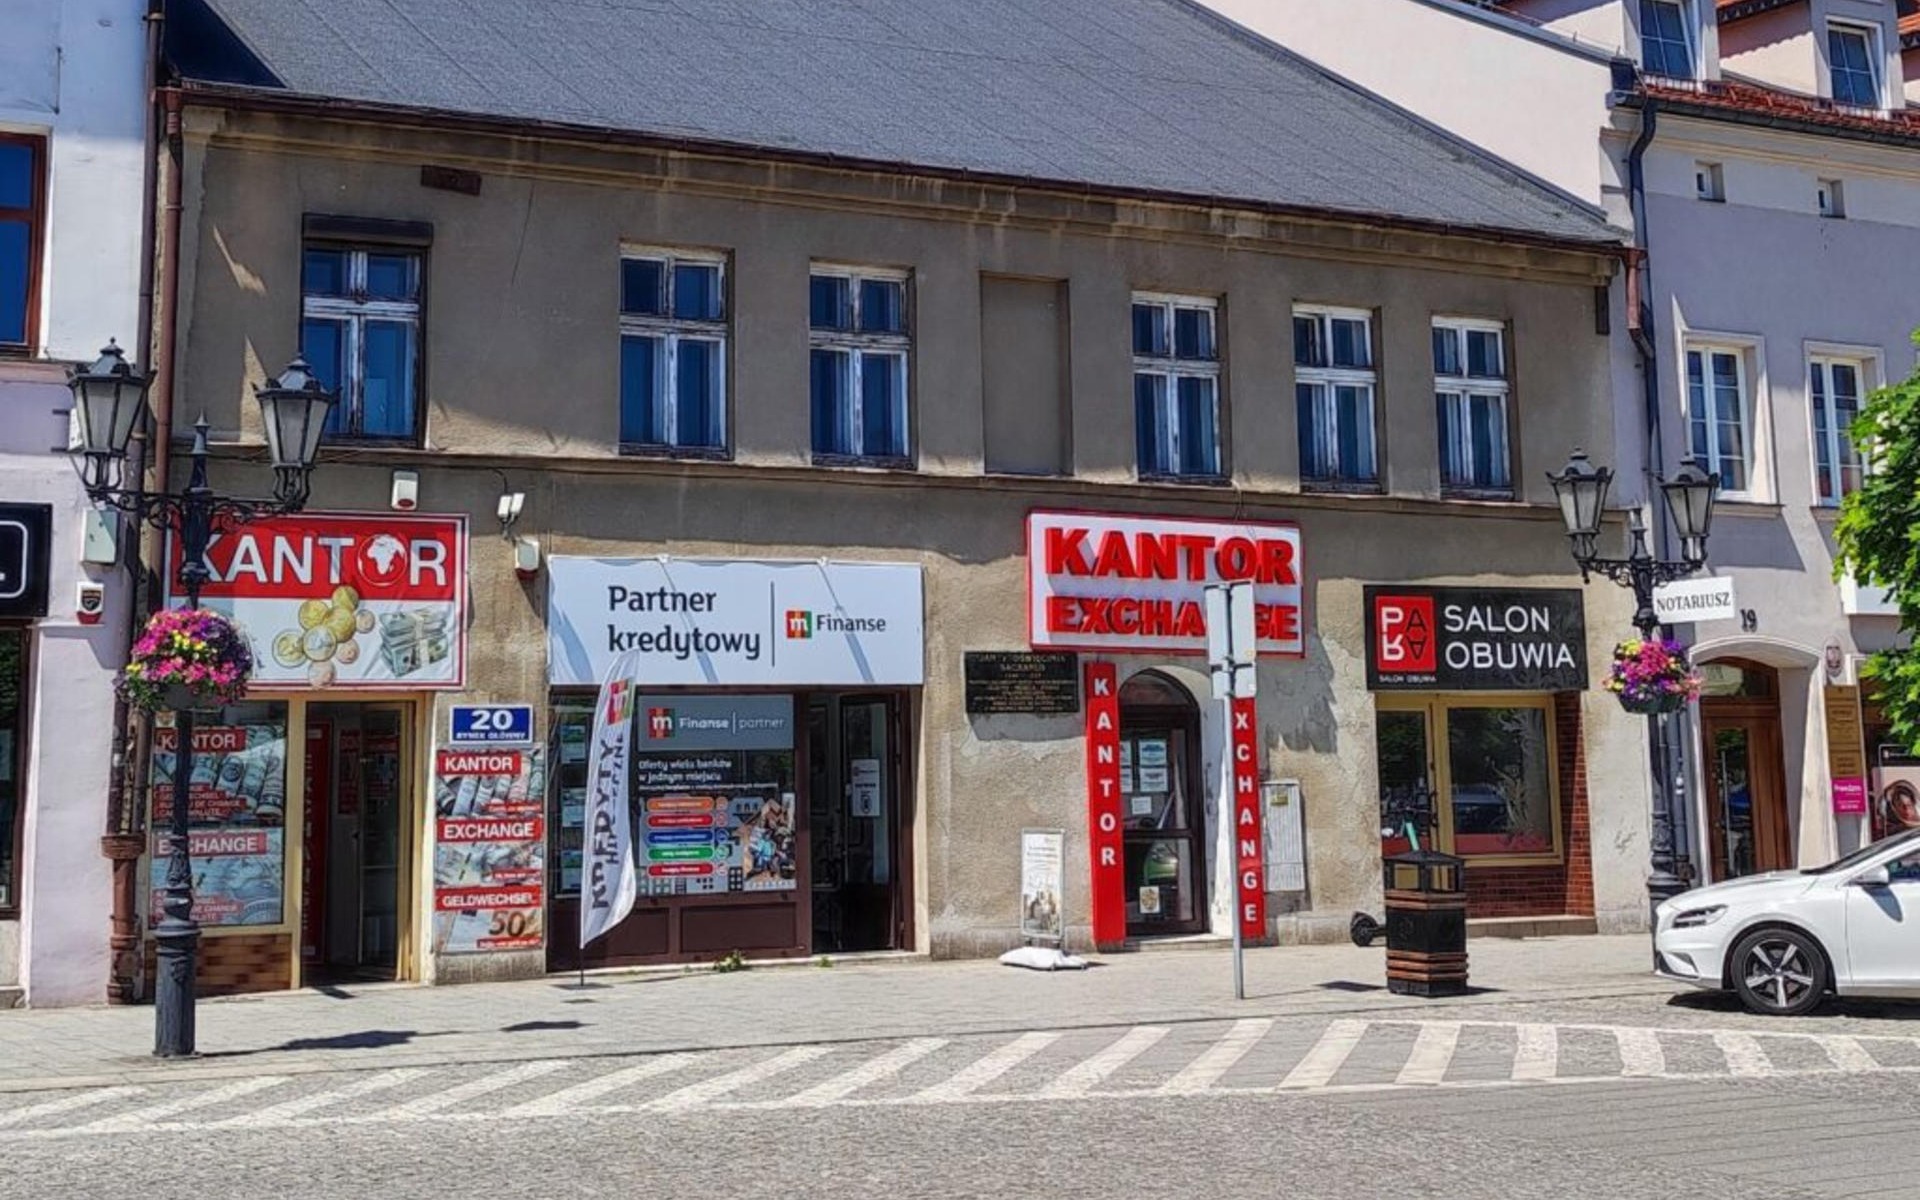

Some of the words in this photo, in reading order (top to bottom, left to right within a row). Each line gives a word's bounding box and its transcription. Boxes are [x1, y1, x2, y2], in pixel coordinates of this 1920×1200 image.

[1045, 527, 1297, 585] KANTOR
[607, 585, 717, 612] Partner
[1656, 591, 1731, 612] NOTARIUSZ
[816, 614, 887, 632] Finanse
[1045, 595, 1299, 641] EXCHAGE
[1444, 605, 1550, 633] SALON
[1740, 608, 1758, 633] 19
[607, 624, 761, 661] kredytowy
[1445, 641, 1576, 669] OBUWIA
[470, 709, 514, 731] 20
[678, 716, 729, 729] Finanse
[738, 717, 785, 731] partner
[161, 733, 237, 750] KNTOR
[445, 756, 513, 772] KANTOR
[638, 759, 669, 771] Oferty
[1094, 677, 1116, 866] KANTOR
[647, 771, 683, 784] jednym
[1235, 711, 1258, 921] XCHANGE
[443, 822, 535, 839] EXCHANGE
[442, 892, 533, 907] GELDWECHSEL
